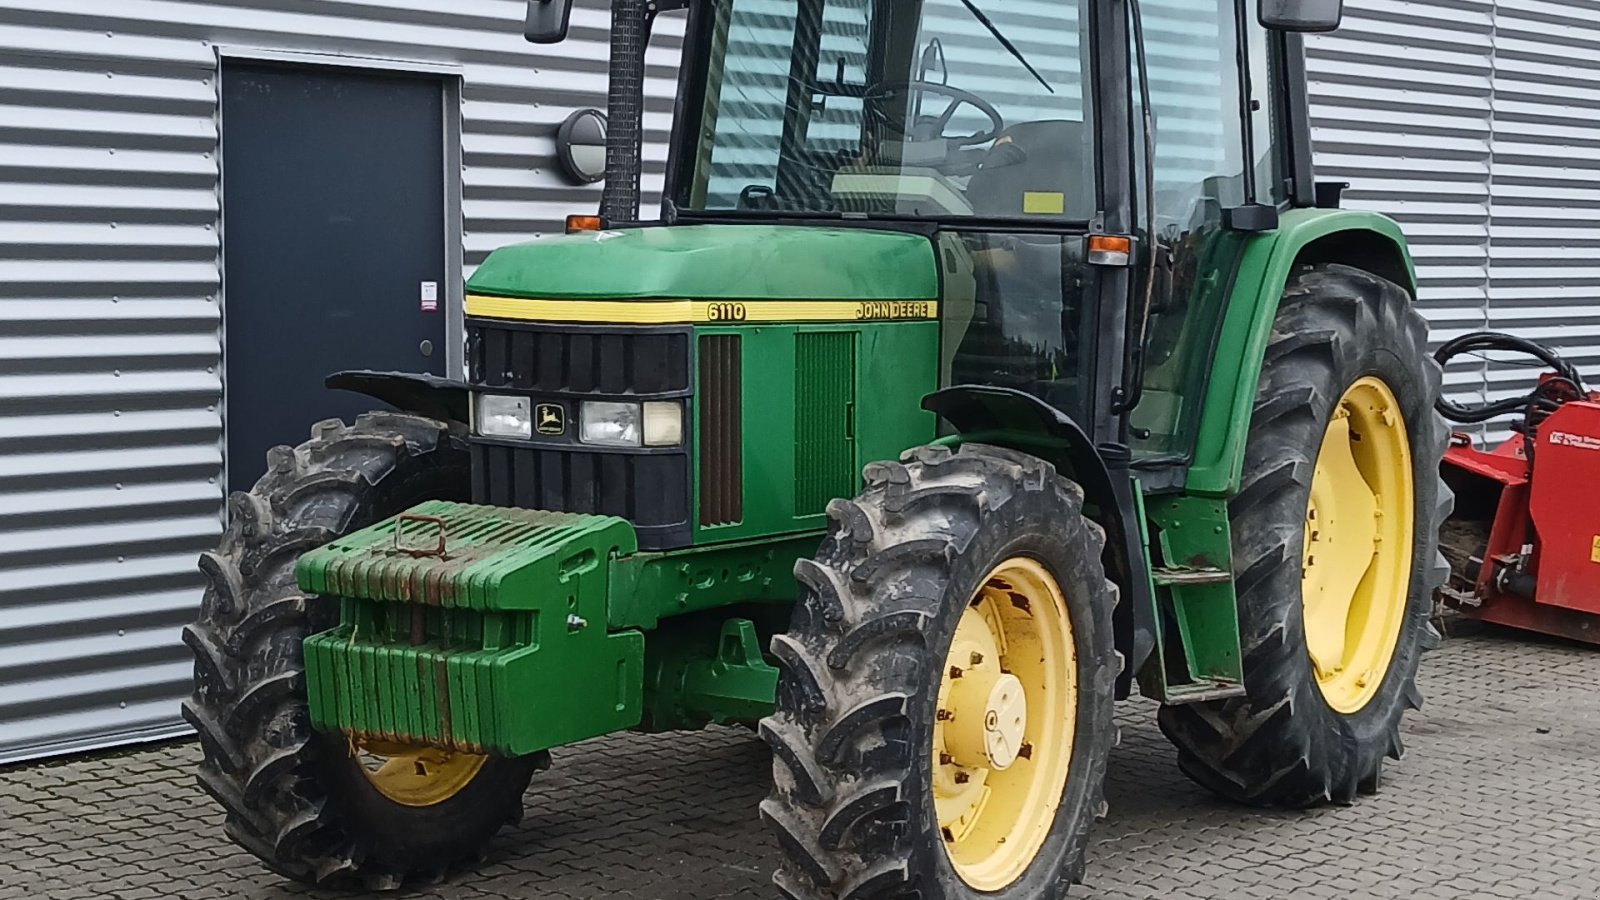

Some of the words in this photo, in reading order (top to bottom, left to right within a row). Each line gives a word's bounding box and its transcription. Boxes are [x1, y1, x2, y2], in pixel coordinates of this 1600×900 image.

[707, 302, 746, 321] 6110
[856, 302, 889, 319] JOHN
[891, 301, 928, 319] DEERE
